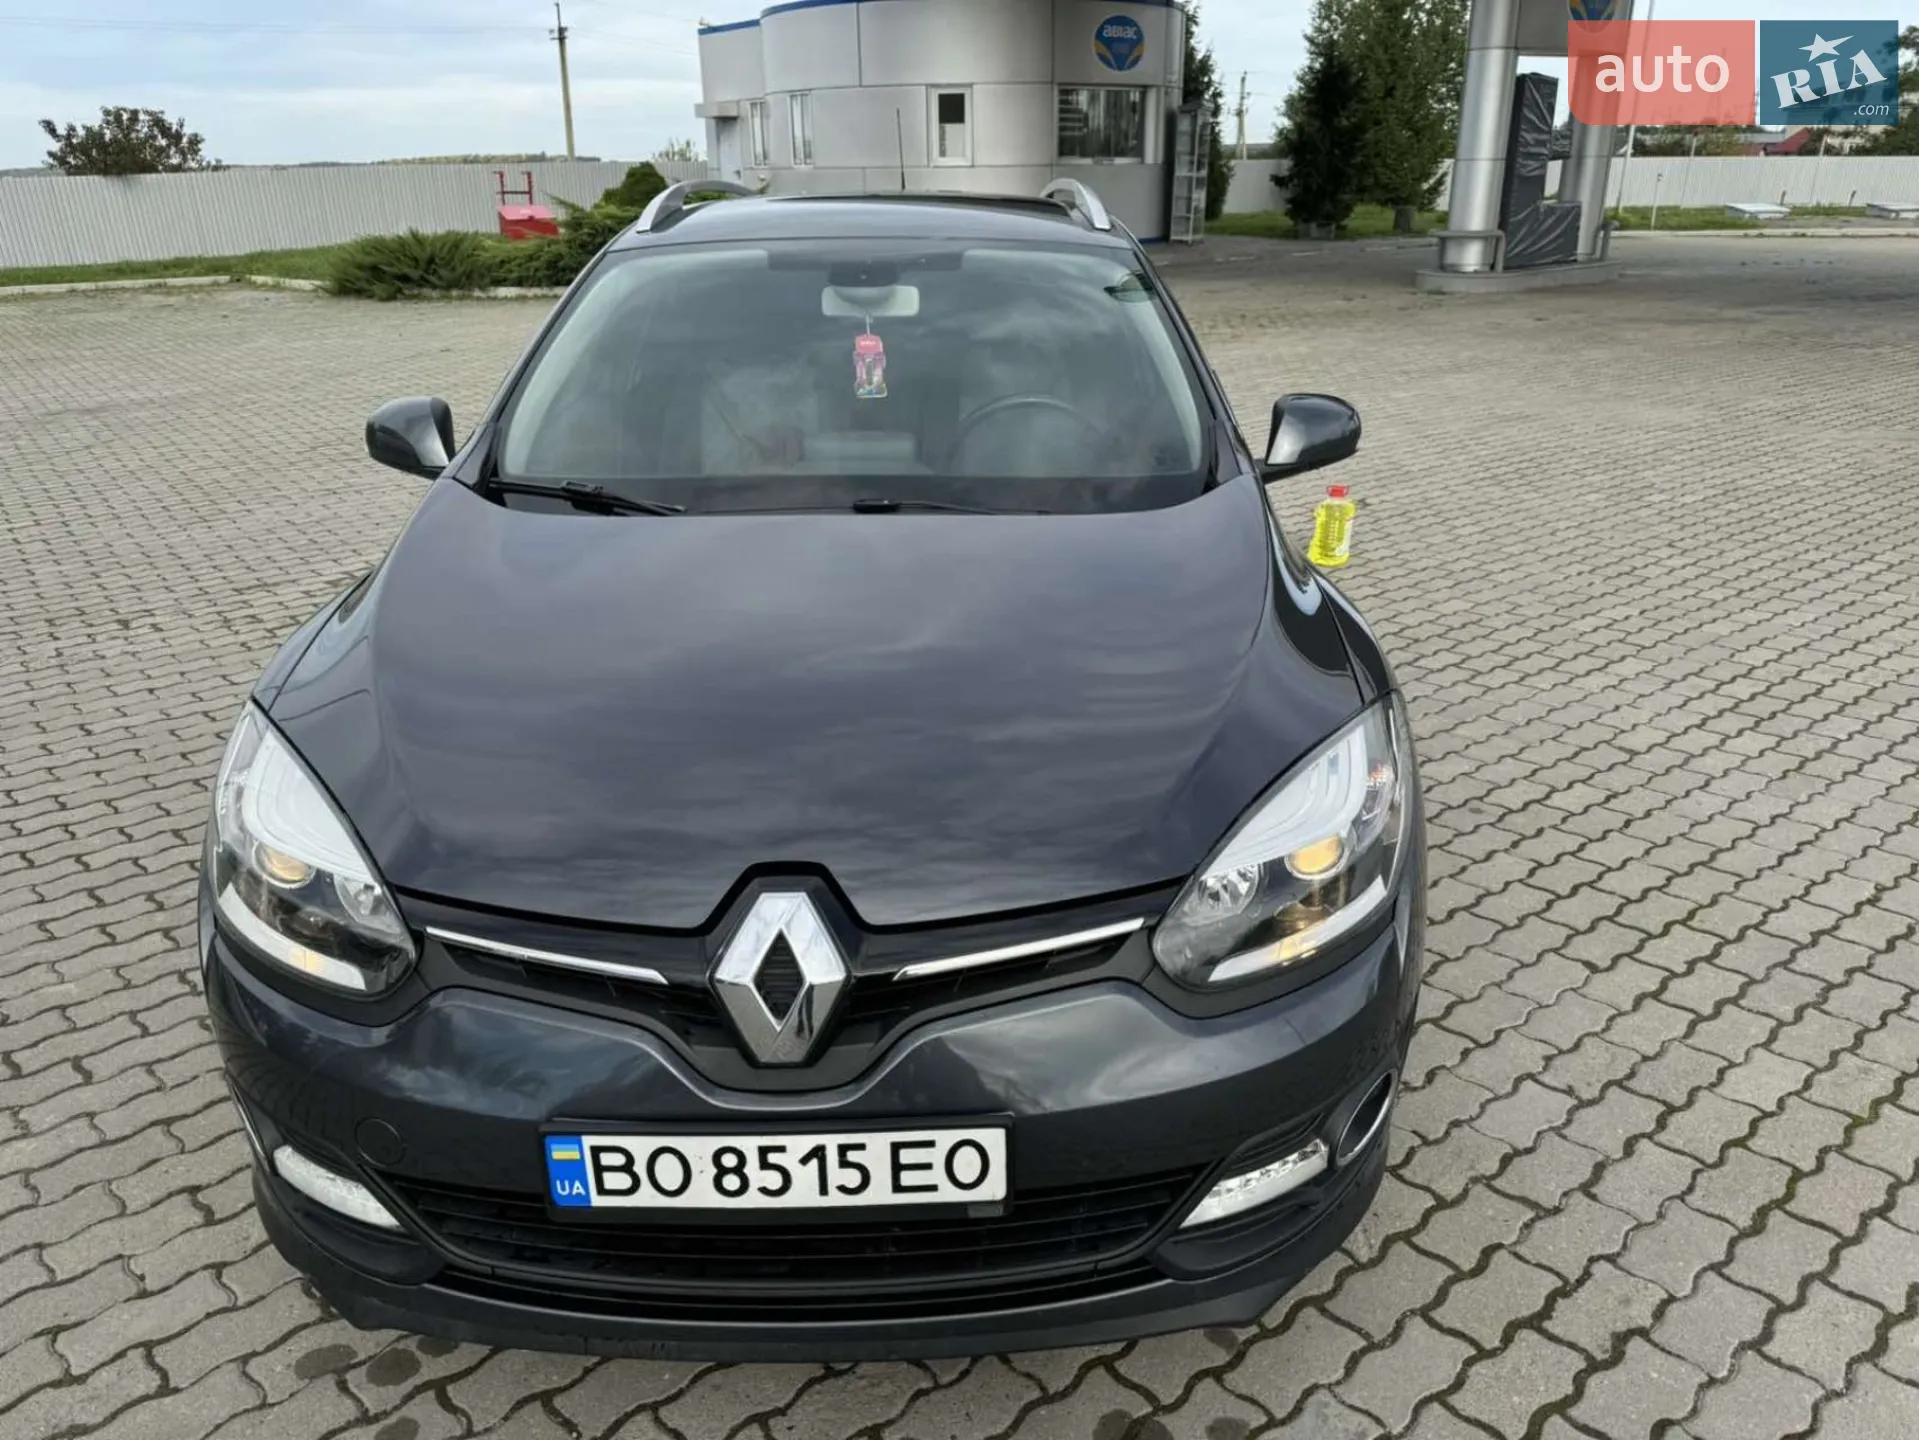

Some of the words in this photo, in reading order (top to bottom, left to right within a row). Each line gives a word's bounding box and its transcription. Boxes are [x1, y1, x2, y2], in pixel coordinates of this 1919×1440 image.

[590, 1144, 692, 1198] BO
[712, 1142, 871, 1199] 8515
[891, 1137, 991, 1194] EO
[556, 1180, 586, 1197] UA
